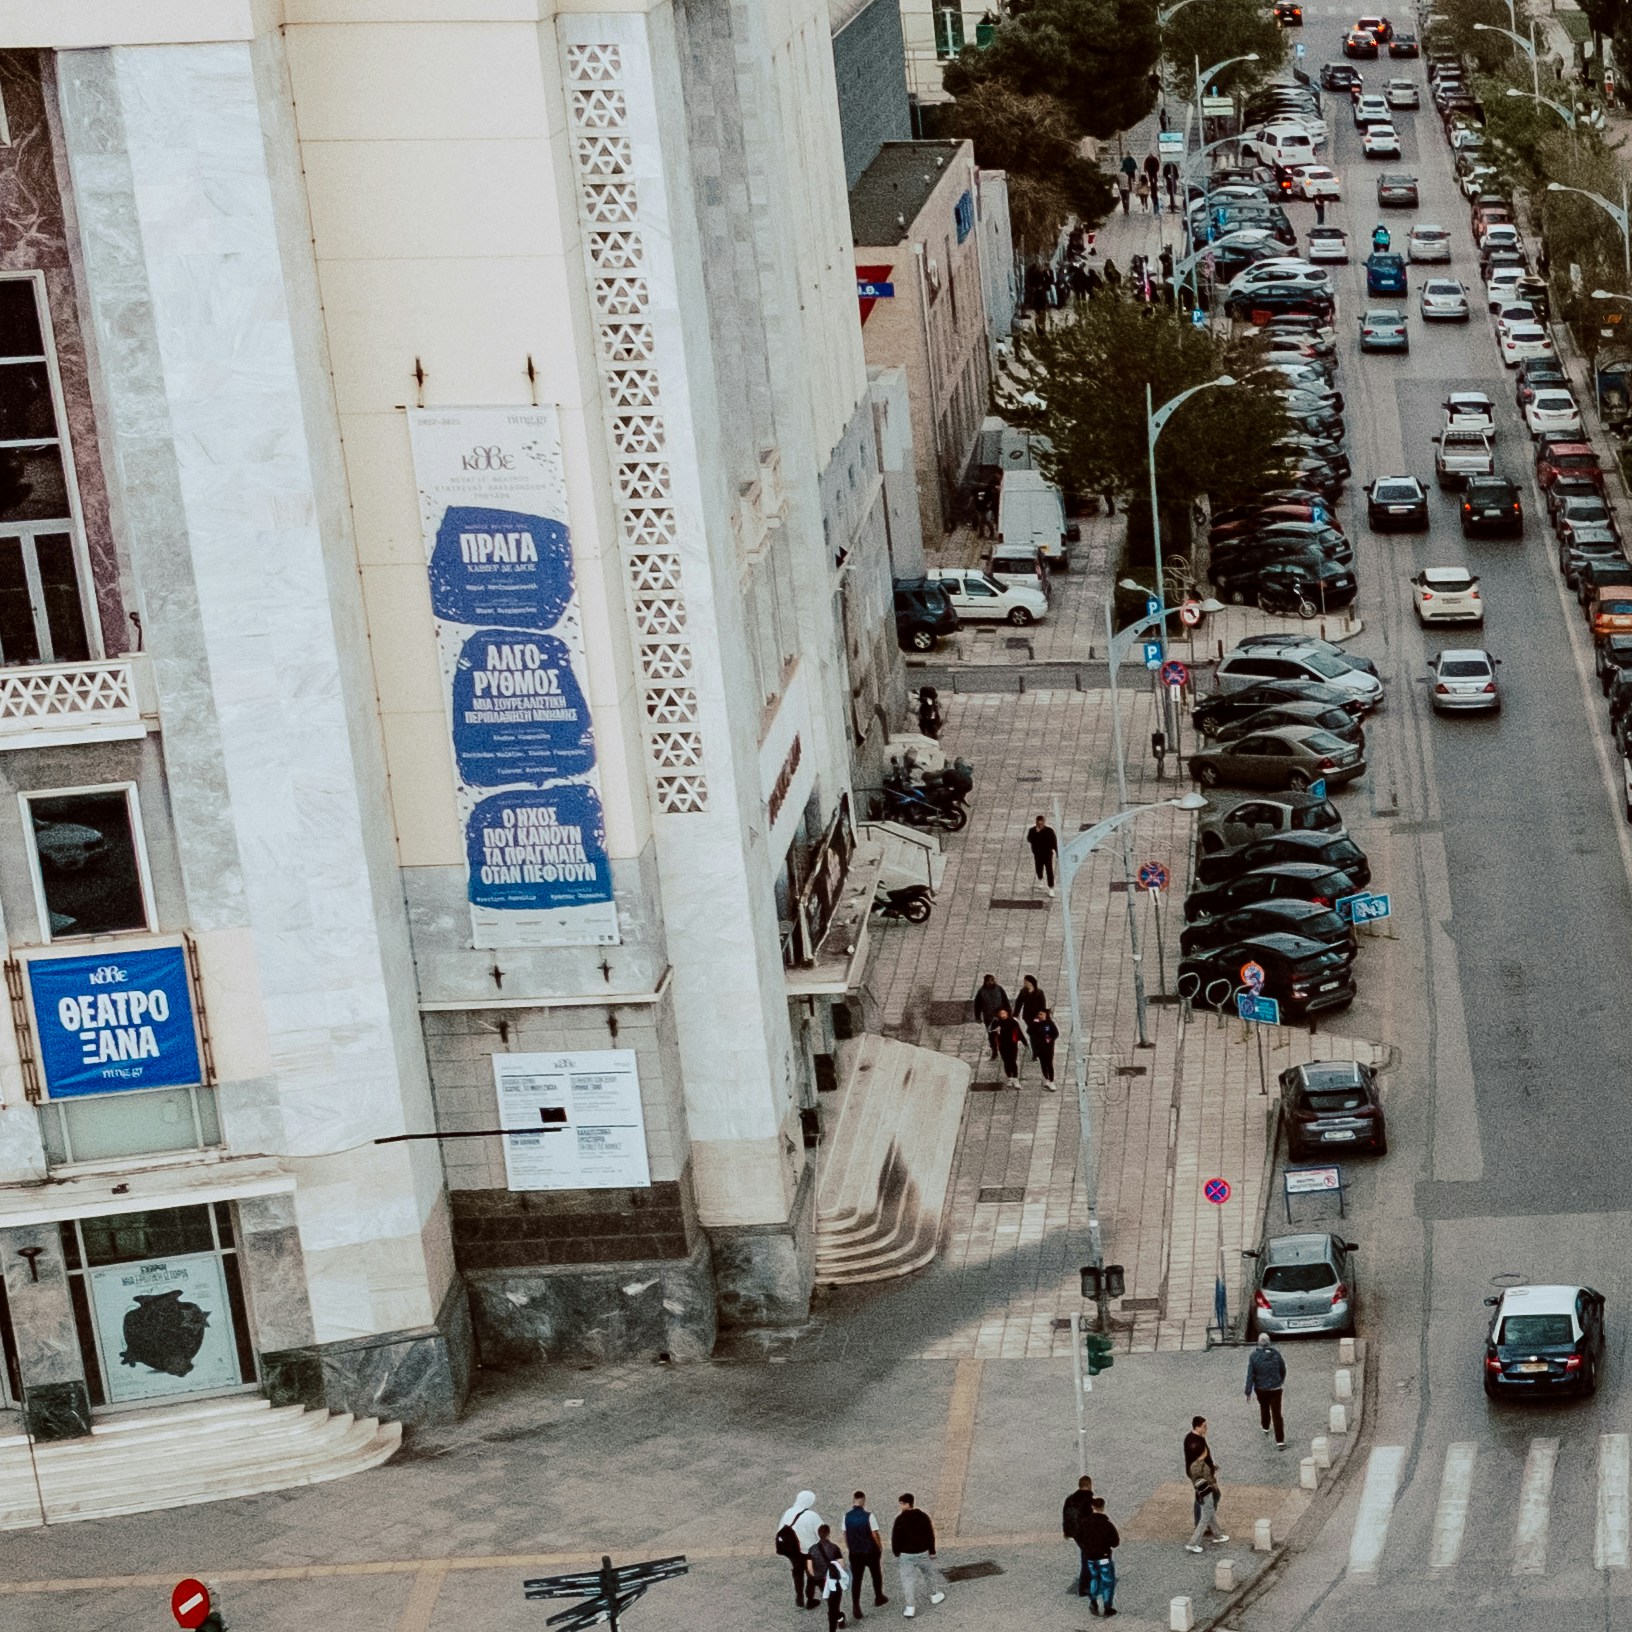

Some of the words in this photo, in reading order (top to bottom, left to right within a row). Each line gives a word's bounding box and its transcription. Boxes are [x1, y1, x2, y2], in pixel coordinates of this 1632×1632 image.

[460, 532, 538, 563] ΠΡΑΓΑ
[487, 644, 548, 671] ΑΛΓΟ-
[1147, 645, 1157, 659] P
[472, 669, 561, 696] ΡΥΘΜΟΣ
[502, 809, 515, 828] Ο
[516, 807, 558, 827] ΗΧΟΣ
[483, 828, 514, 847] ΠΟΥ
[517, 826, 582, 846] ΚΑΝΟΥΝ
[483, 847, 505, 866] ΤΑ
[505, 845, 588, 865] ΠΡΑΓΜΑΤΑ
[481, 866, 522, 885] ΟΤΑΝ
[524, 863, 597, 883] ΠΕΦΤΟΥΝ
[58, 989, 170, 1032] ΘΕΑΤΡΟ
[79, 1026, 160, 1065] ΞΑΝΑ
